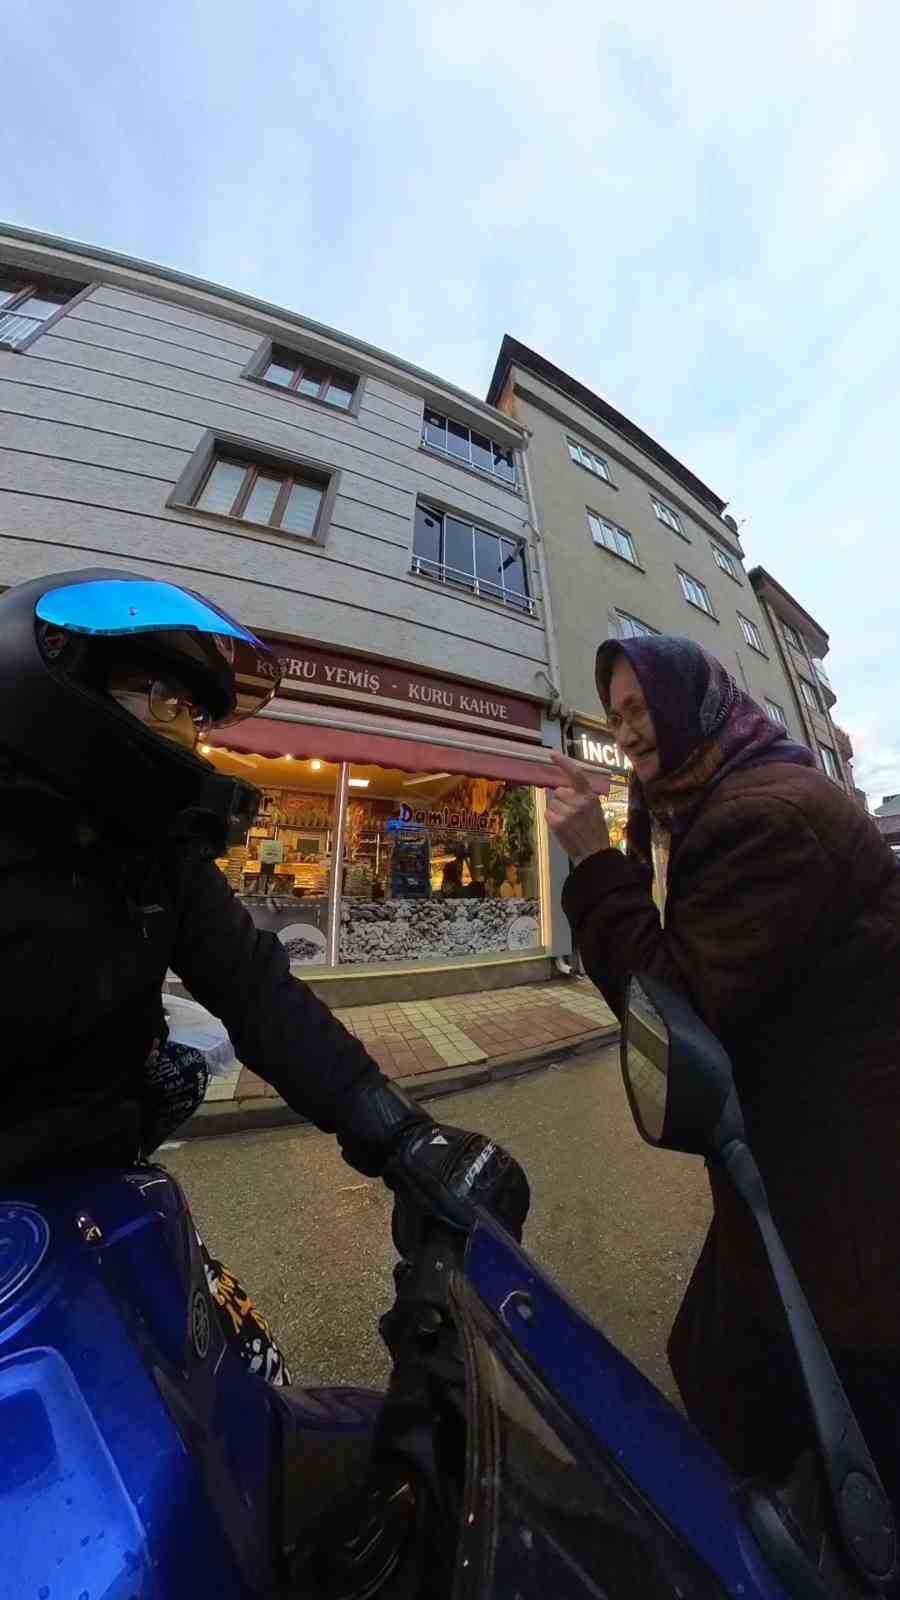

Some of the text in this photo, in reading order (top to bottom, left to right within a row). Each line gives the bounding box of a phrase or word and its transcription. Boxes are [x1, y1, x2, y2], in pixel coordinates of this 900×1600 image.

[324, 665, 380, 693] YEMİŞ
[408, 683, 454, 706] KURU
[460, 695, 508, 719] KAHVE
